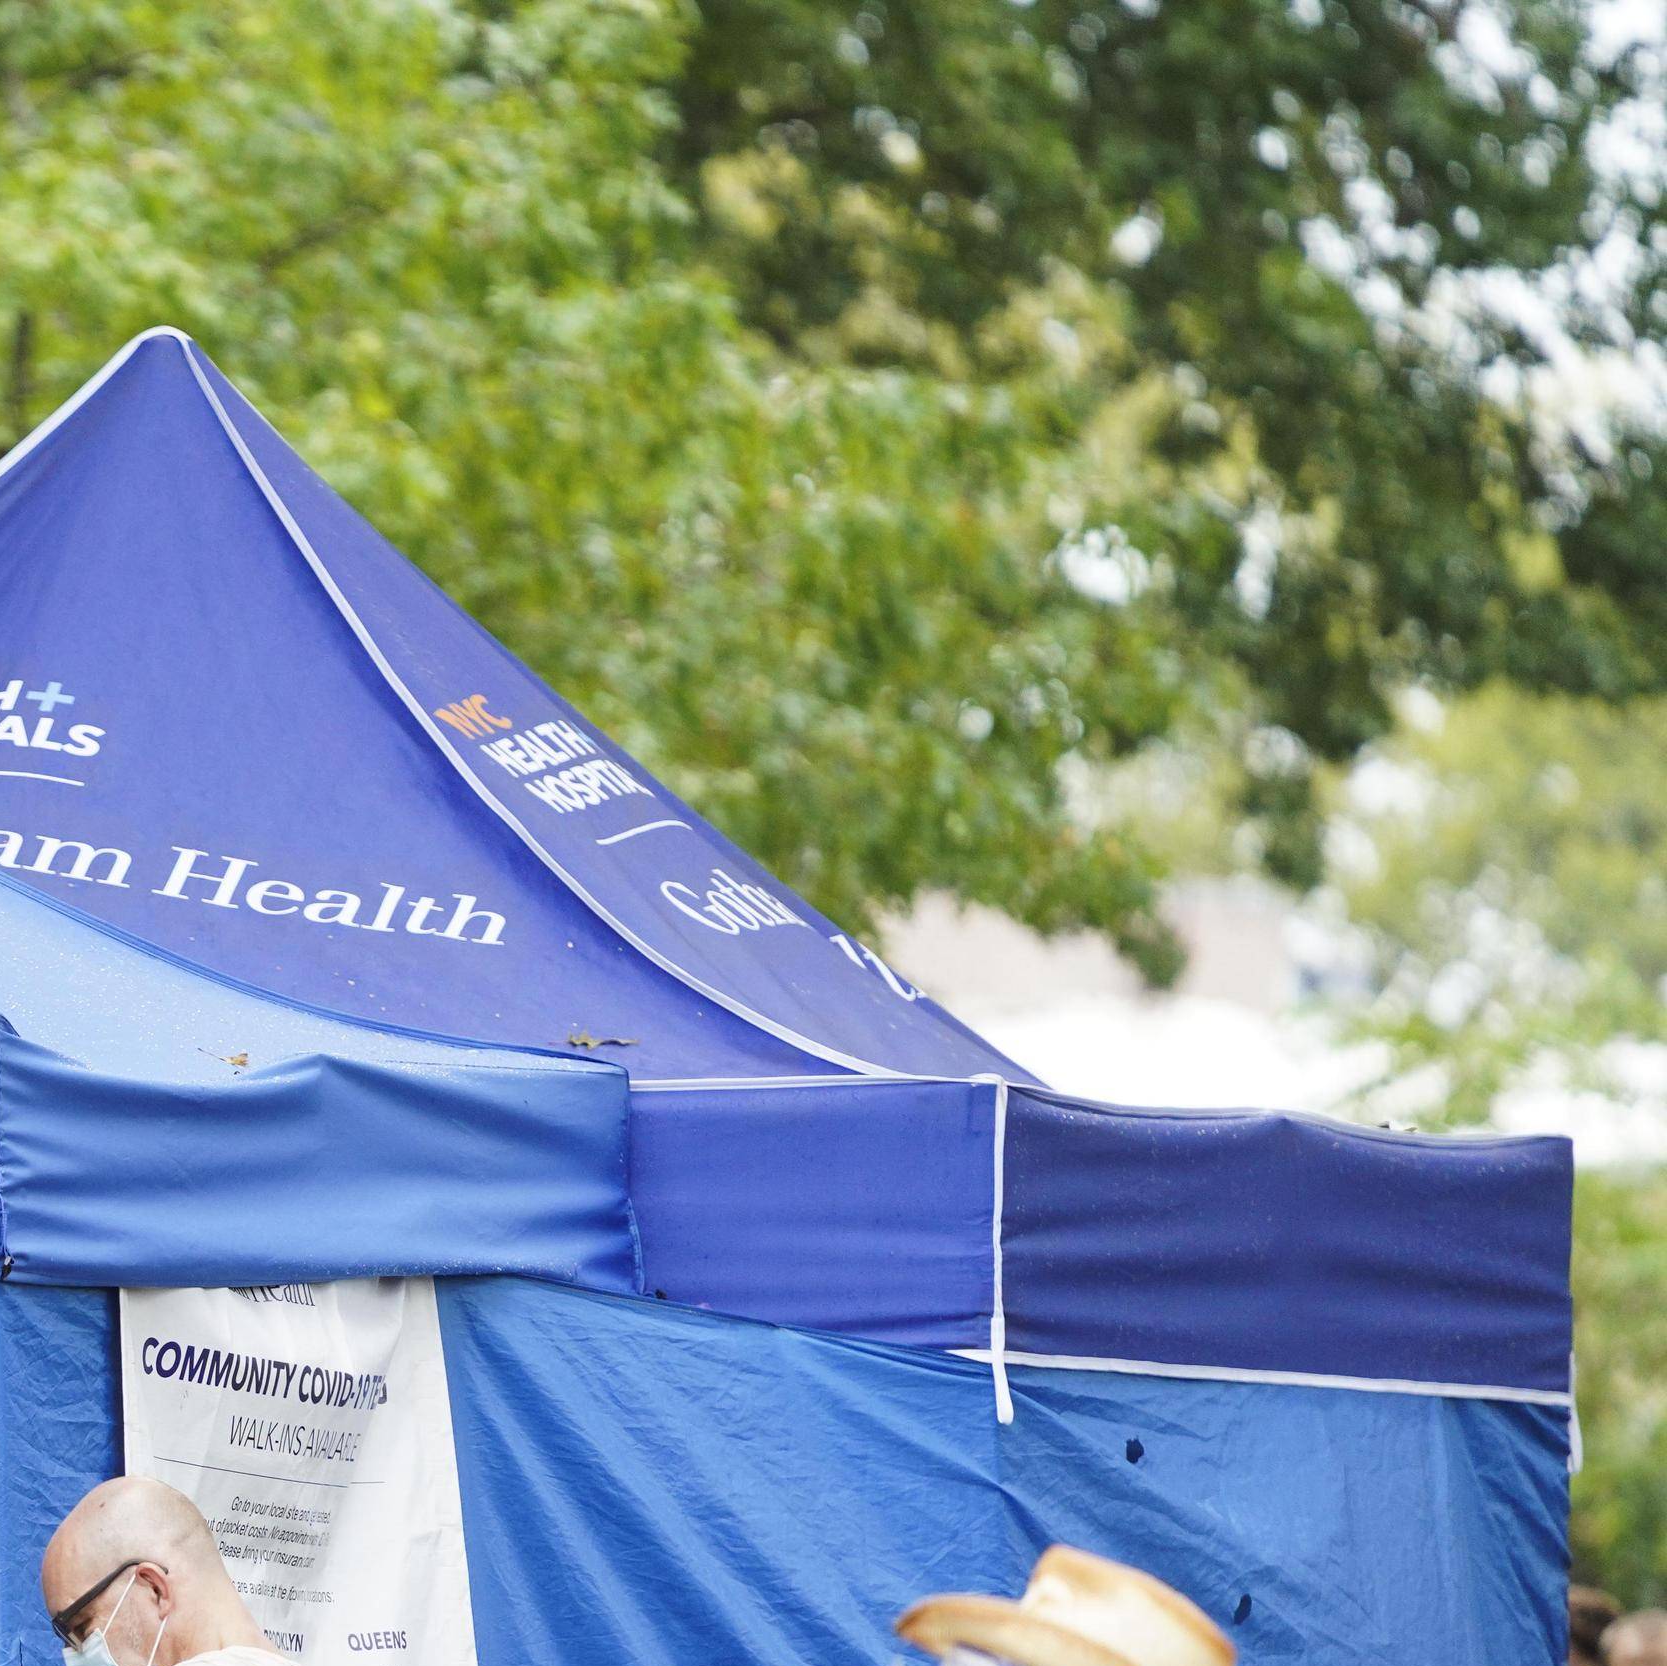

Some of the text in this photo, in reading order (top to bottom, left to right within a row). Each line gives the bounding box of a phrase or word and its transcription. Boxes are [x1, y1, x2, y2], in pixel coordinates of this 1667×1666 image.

[433, 693, 513, 740] NYC
[523, 758, 656, 814] HOSPITA
[151, 845, 507, 946] Health
[142, 1337, 298, 1399] COMMUNITY
[299, 1364, 370, 1410] COVID-19
[229, 1415, 306, 1456] WALK-INS
[231, 1496, 242, 1511] Go
[242, 1499, 251, 1512] to
[249, 1503, 269, 1516] your
[269, 1502, 287, 1519] local
[219, 1541, 241, 1558] Please
[348, 1630, 408, 1651] QUEENS
